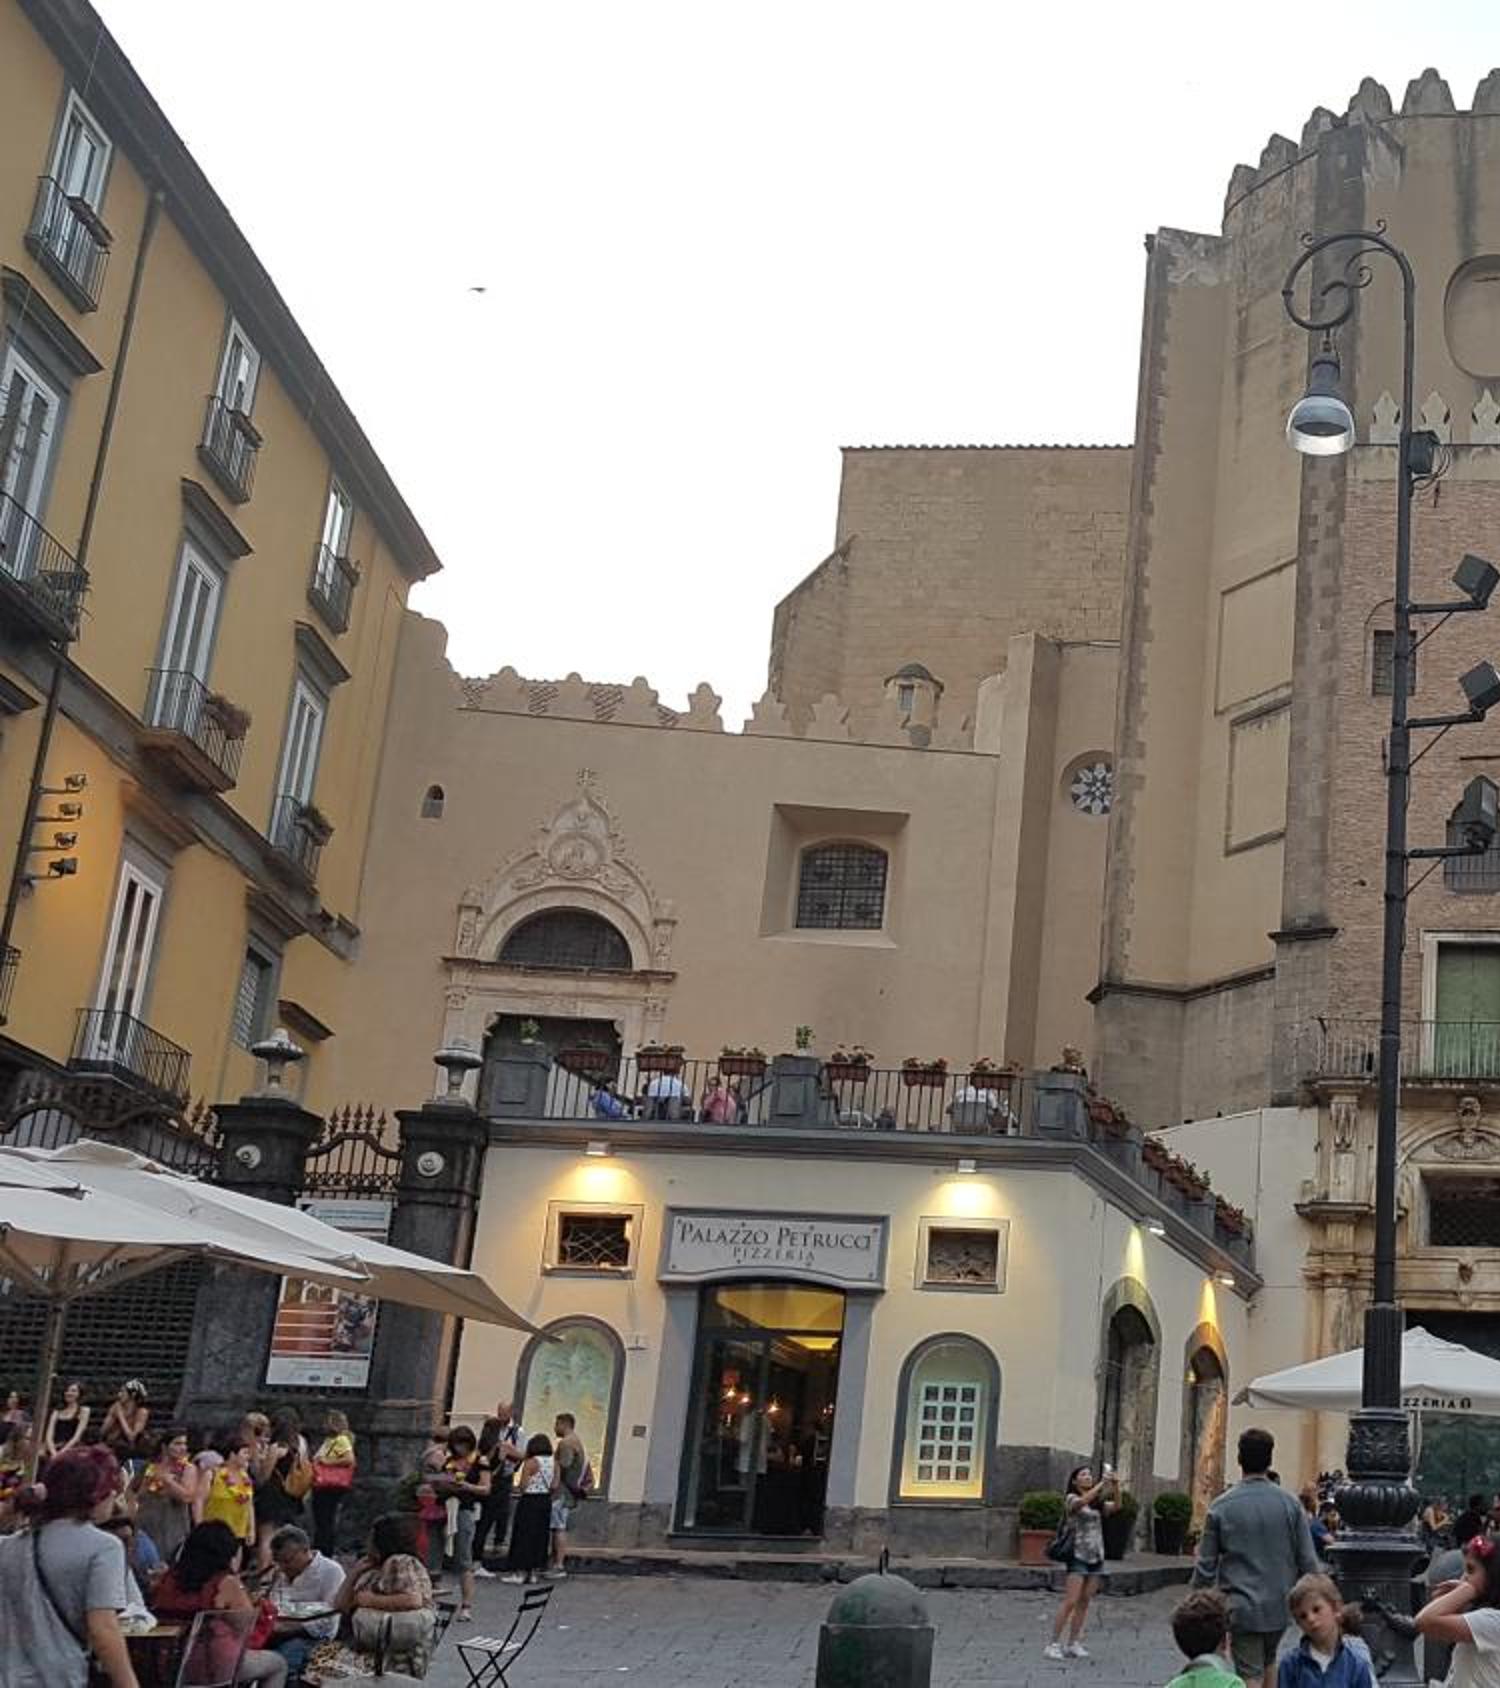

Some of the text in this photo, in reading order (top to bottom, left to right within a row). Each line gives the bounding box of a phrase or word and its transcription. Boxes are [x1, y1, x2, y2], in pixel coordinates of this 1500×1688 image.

[680, 1221, 871, 1250] PALAZZO PETRUCCI
[733, 1246, 815, 1261] PIZZERIA
[1402, 1397, 1456, 1409] ZZERIA
